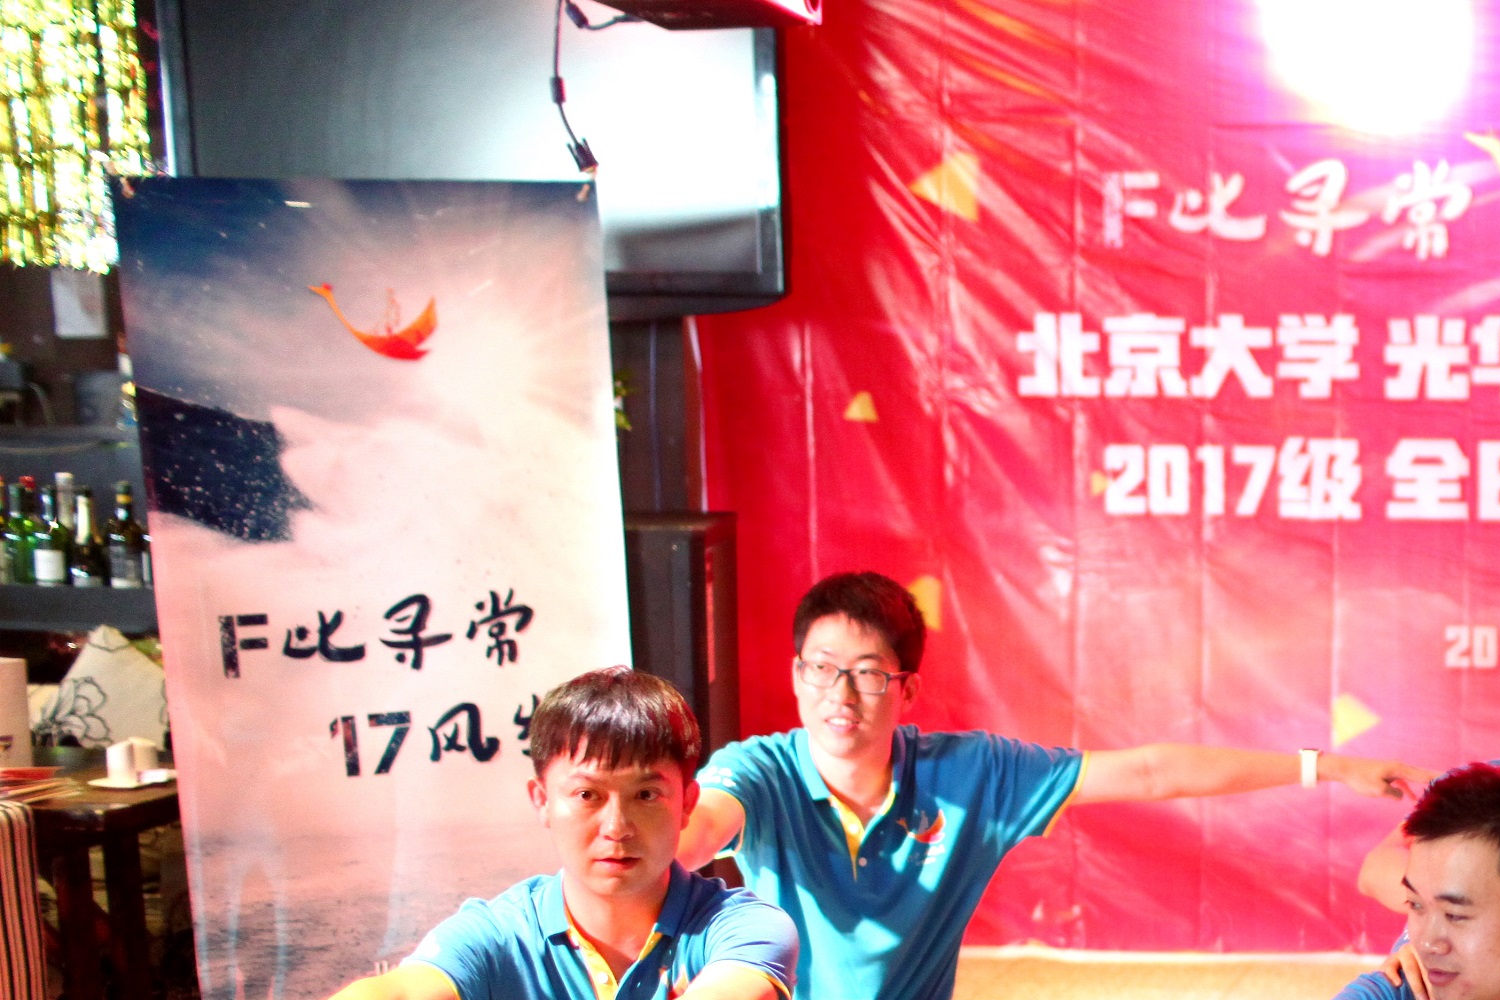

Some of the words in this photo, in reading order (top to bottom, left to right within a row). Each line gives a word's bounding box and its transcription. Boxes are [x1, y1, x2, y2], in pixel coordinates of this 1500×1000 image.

[1015, 312, 1361, 399] 北京大学
[1103, 437, 1363, 521] 2017级
